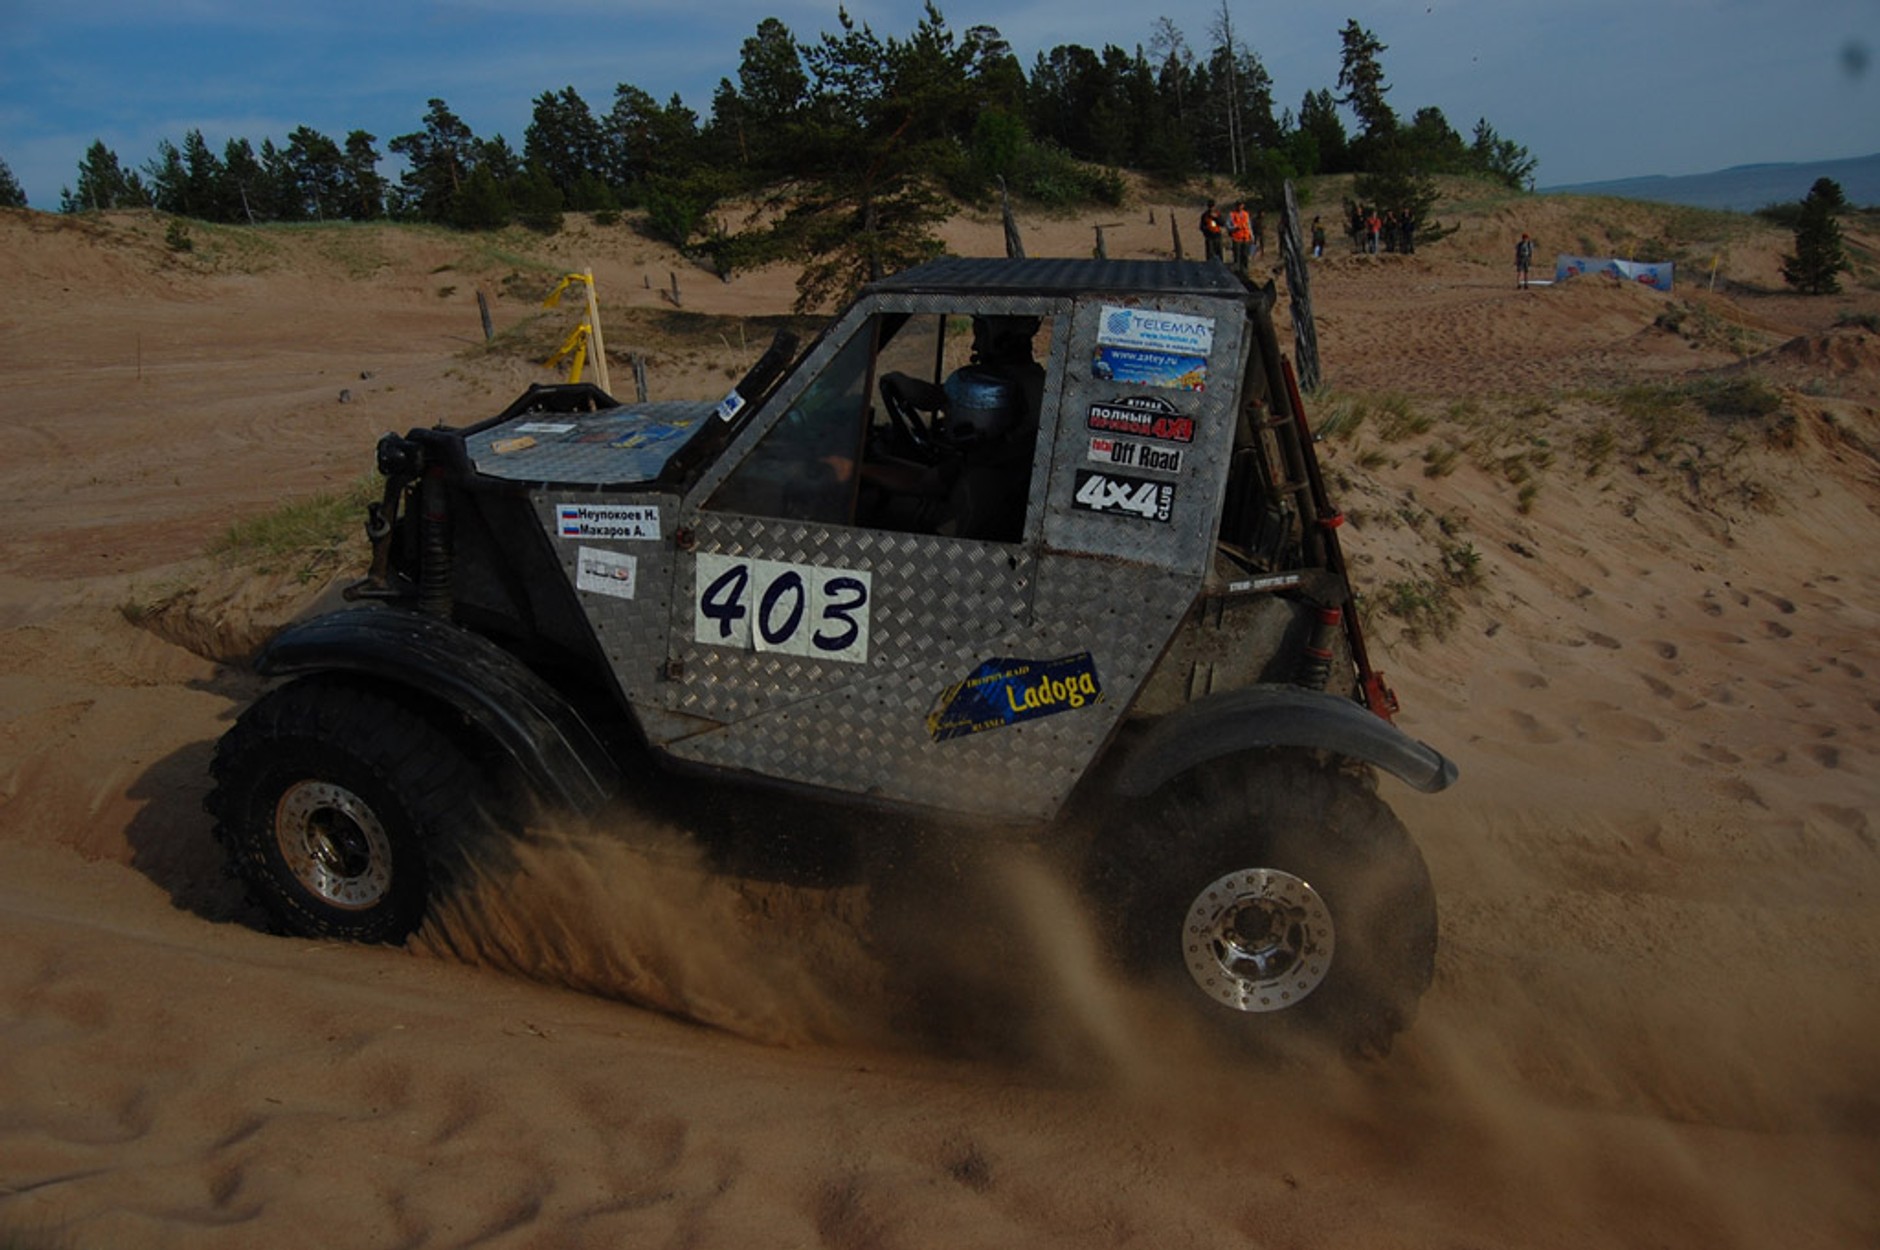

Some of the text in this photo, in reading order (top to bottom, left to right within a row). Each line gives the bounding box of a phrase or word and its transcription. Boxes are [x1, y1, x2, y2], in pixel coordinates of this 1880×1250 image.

[1133, 316, 1206, 336] TELEMAR
[1111, 442, 1136, 464] Off
[1139, 446, 1180, 471] Road
[578, 508, 657, 522] Неупокоев Н.
[1158, 486, 1173, 520] CLUB
[580, 524, 646, 537] Макаров А.
[700, 564, 868, 652] 403
[1006, 671, 1096, 712] Ladoga
